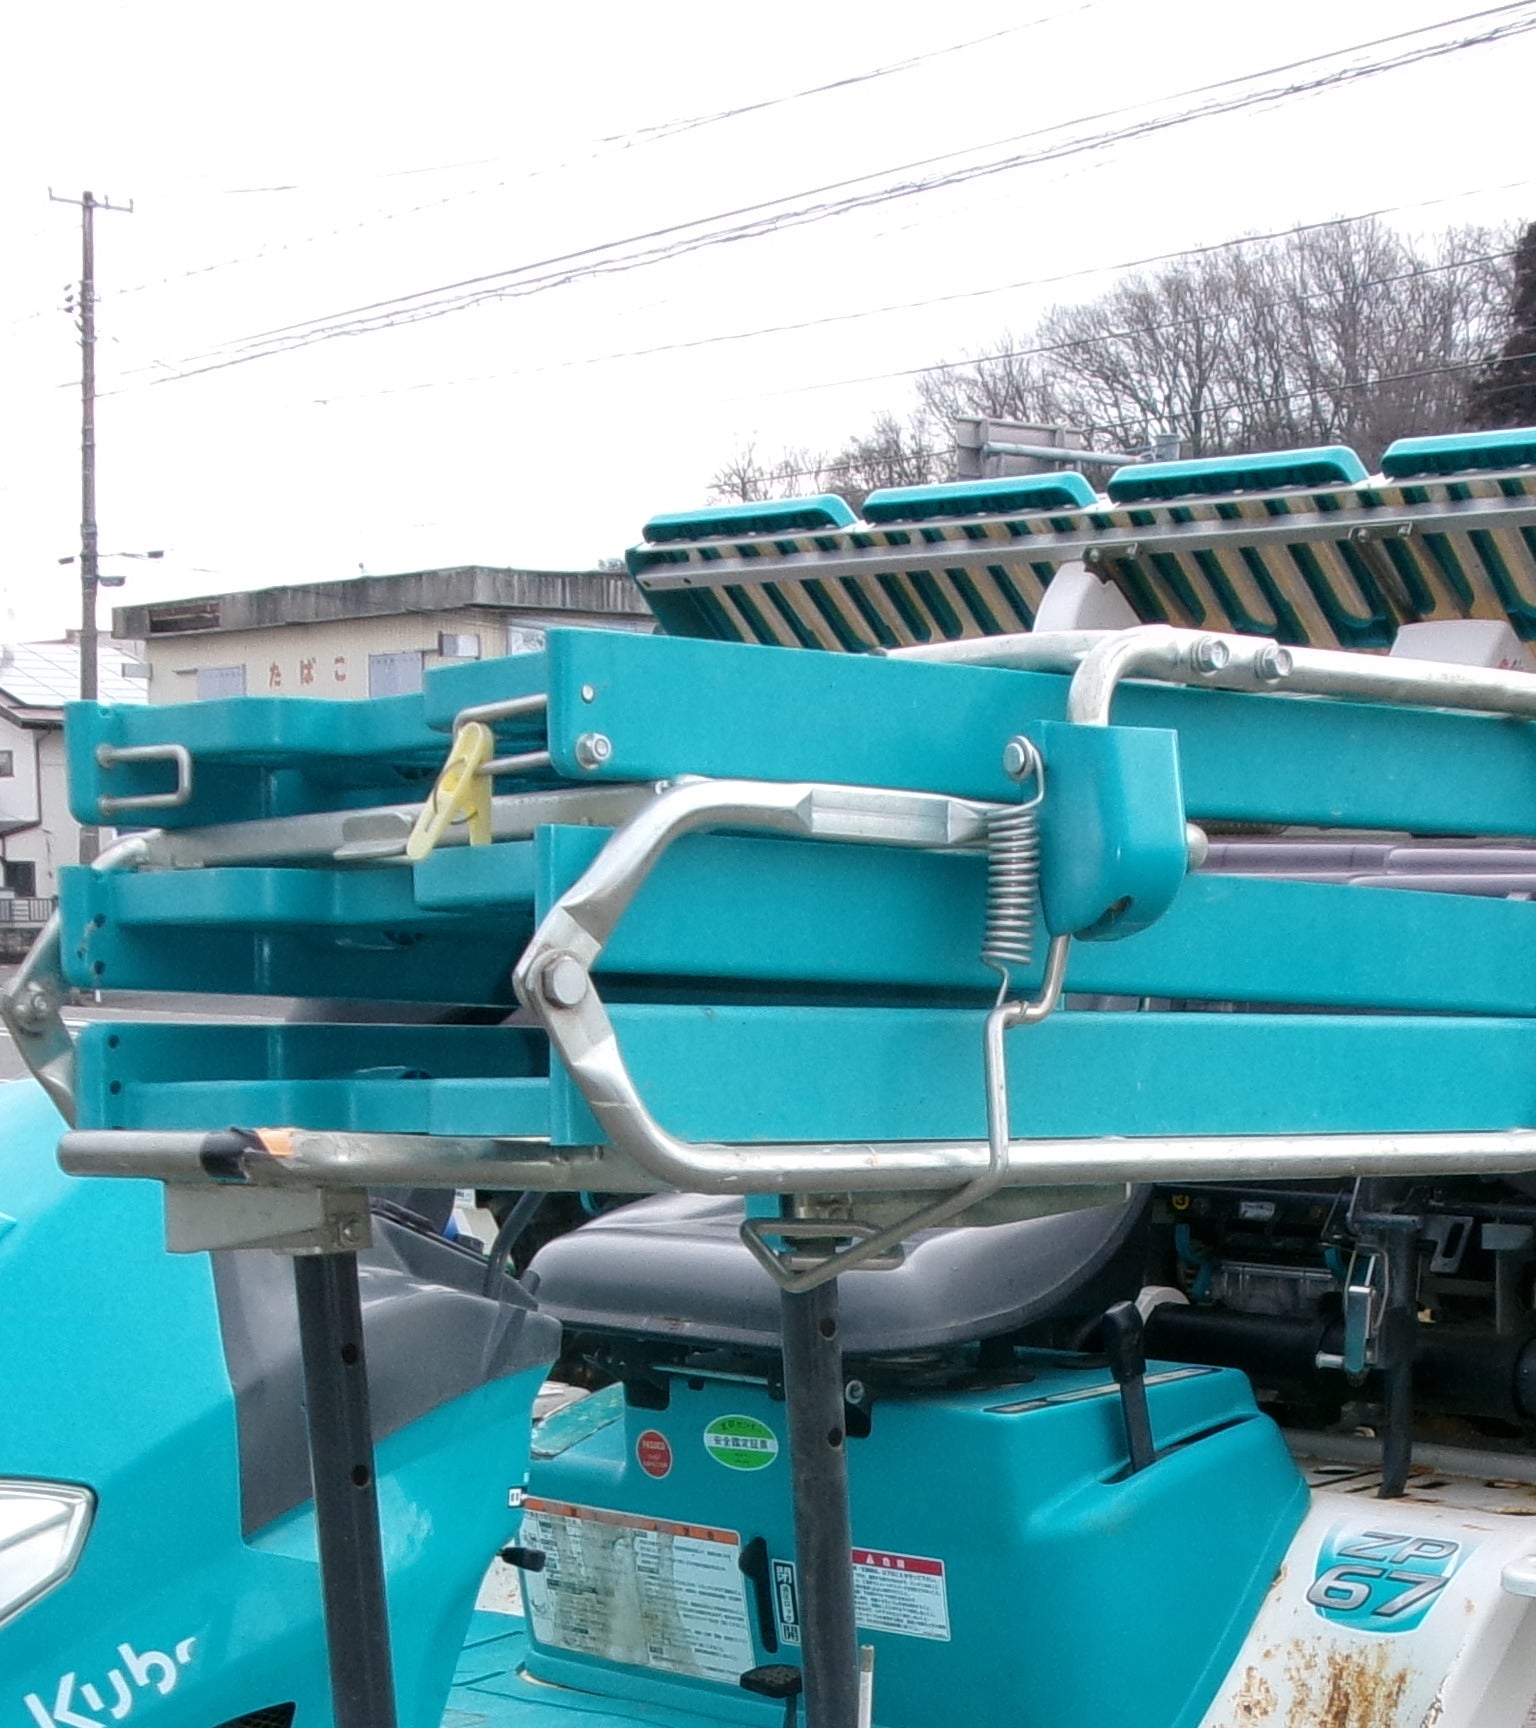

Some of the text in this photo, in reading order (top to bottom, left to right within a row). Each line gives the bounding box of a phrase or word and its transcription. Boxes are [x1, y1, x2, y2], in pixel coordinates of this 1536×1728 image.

[269, 656, 346, 688] たばこ
[1337, 1531, 1460, 1564] ZP
[776, 1566, 792, 1584] 閉
[1306, 1564, 1451, 1617] 67
